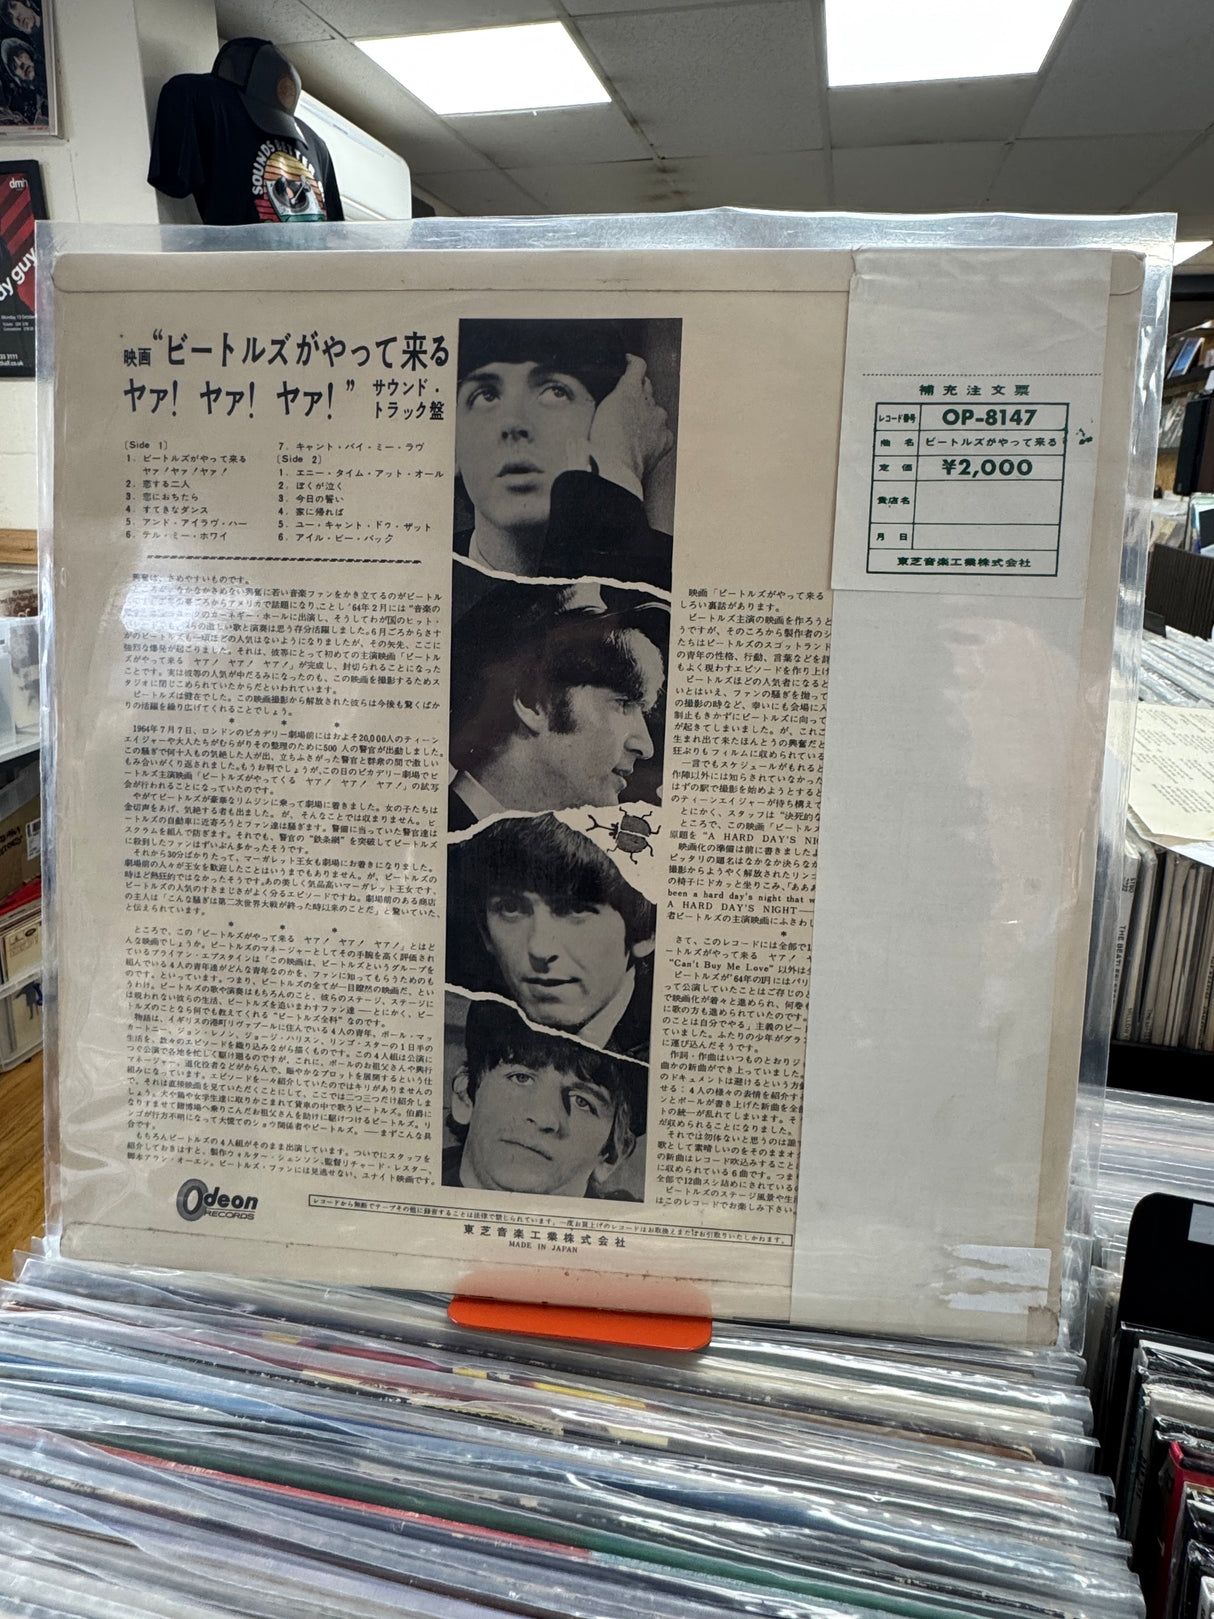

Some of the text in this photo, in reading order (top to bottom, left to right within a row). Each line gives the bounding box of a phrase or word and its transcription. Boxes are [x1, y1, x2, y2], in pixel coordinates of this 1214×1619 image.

[252, 140, 276, 196] SOUNDS
[124, 347, 152, 367] 映画
[919, 384, 1031, 397] 補充注文票
[373, 400, 445, 420] トラック盤
[879, 412, 916, 424] レコード番号
[942, 408, 1038, 427] OP-8147
[925, 436, 1057, 448] ビートルズがやって来る
[143, 454, 247, 463] ビートルズがやって来る
[296, 469, 444, 478] エニー・タイム・アット・オール
[942, 458, 1033, 478] ¥2,000
[143, 480, 190, 489] 恋する二人
[143, 492, 199, 501] 恋におちたら
[296, 494, 344, 503] 今日の誓い
[877, 495, 911, 505] 貴店名
[143, 506, 208, 514] すてきなダンス
[296, 507, 344, 517] 家に帰れば
[897, 556, 1031, 568] 東芝音楽工業株式会社
[680, 599, 780, 614] しろい裏話があります。
[724, 832, 754, 843] HARD
[805, 835, 818, 845] NI
[668, 889, 688, 899] been
[704, 891, 723, 901] hard
[729, 892, 752, 902] day's
[758, 893, 781, 903] night
[787, 894, 804, 904] that
[667, 900, 673, 909] A
[683, 901, 712, 911] HARD
[704, 960, 721, 970] Buy
[727, 962, 740, 971] Me
[176, 1178, 259, 1221] Odeon
[204, 1210, 255, 1221] RECORDS
[463, 1224, 626, 1248] 東芝音楽工業株式会社
[508, 1240, 578, 1253] MADE IN JAPAN
